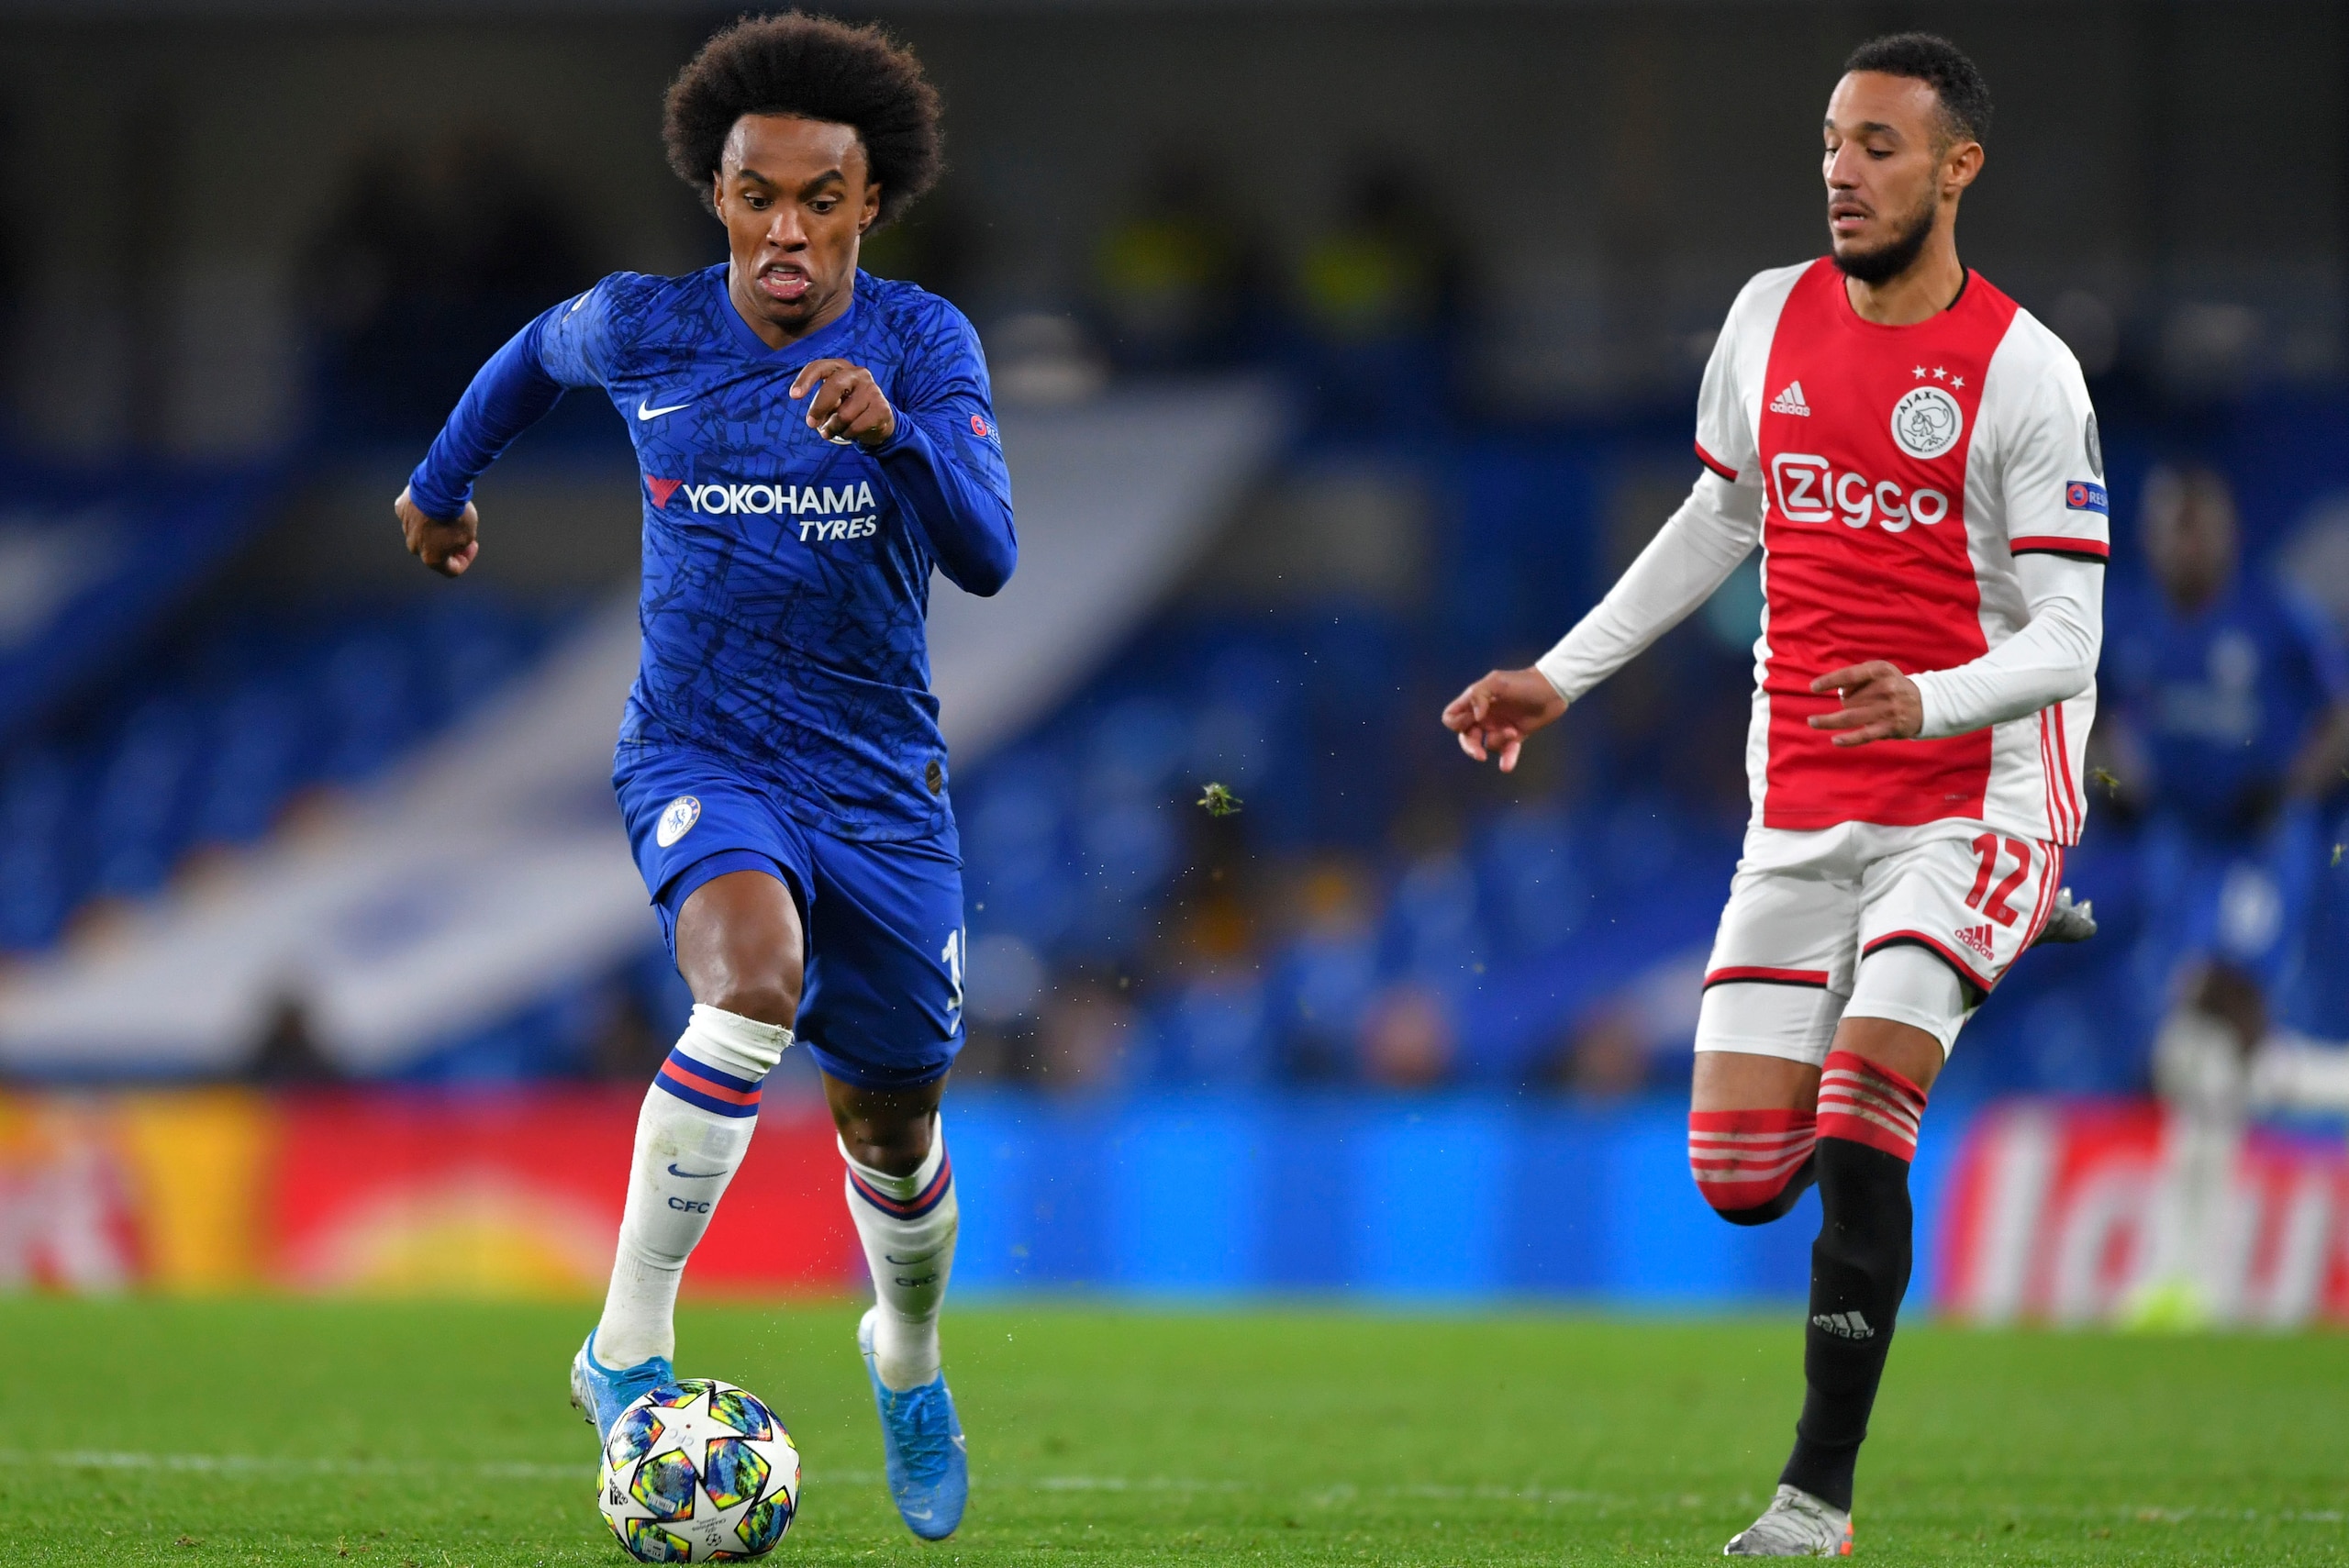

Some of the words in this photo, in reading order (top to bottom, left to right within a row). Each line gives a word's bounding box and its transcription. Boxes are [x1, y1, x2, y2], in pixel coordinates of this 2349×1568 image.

[1769, 402, 1811, 417] adidas
[1899, 391, 1931, 414] AJAX
[682, 481, 876, 515] YOKOHAMA
[799, 515, 877, 542] TYRES
[1965, 832, 2032, 928] 12
[1954, 929, 1995, 962] adidas
[668, 1196, 710, 1214] CFC
[895, 1273, 938, 1287] CFC
[1812, 1315, 1876, 1340] adidas
[669, 1427, 695, 1447] CFC
[609, 1477, 629, 1505] adidas
